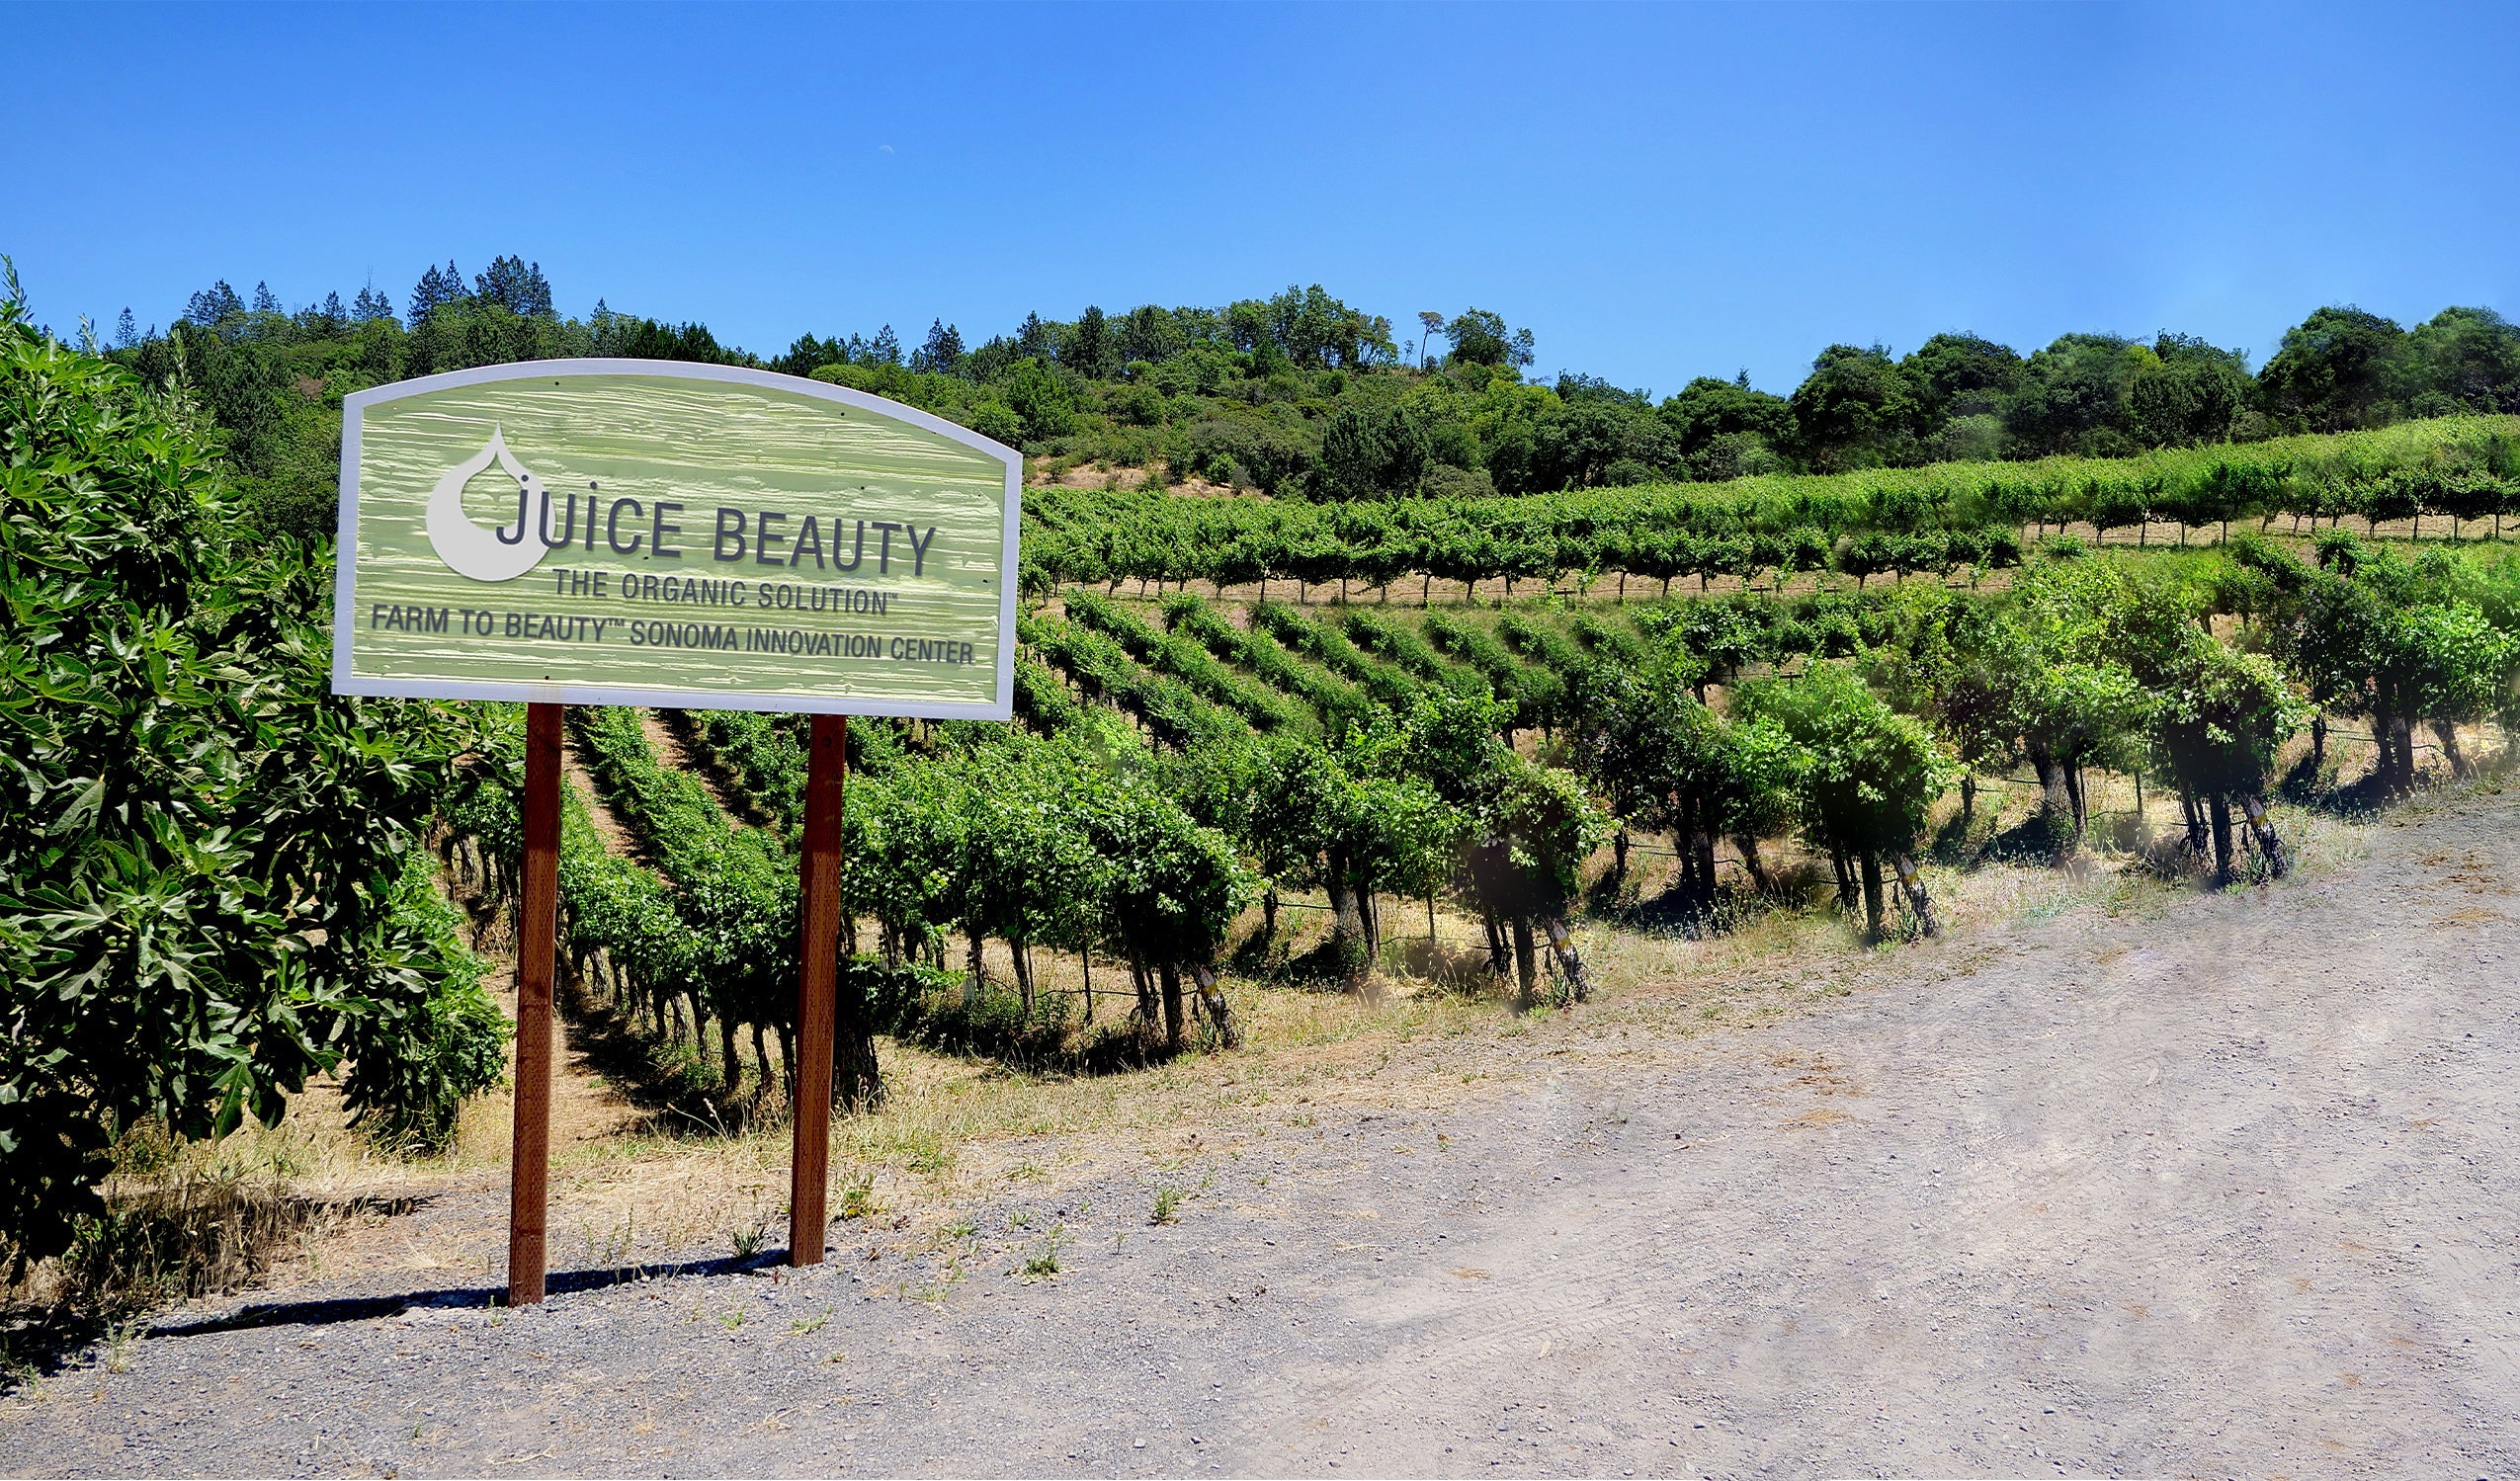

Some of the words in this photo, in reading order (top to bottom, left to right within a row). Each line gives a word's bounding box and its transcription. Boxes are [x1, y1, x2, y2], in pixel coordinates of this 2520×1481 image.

[714, 507, 937, 577] BEAUTY
[552, 568, 608, 598] THE
[622, 573, 746, 606] ORGANIC
[372, 604, 449, 633] FARM
[459, 609, 493, 636] TO
[630, 620, 738, 651] SONOMA
[746, 627, 882, 659] INNOVATION
[890, 637, 973, 664] CENTER
